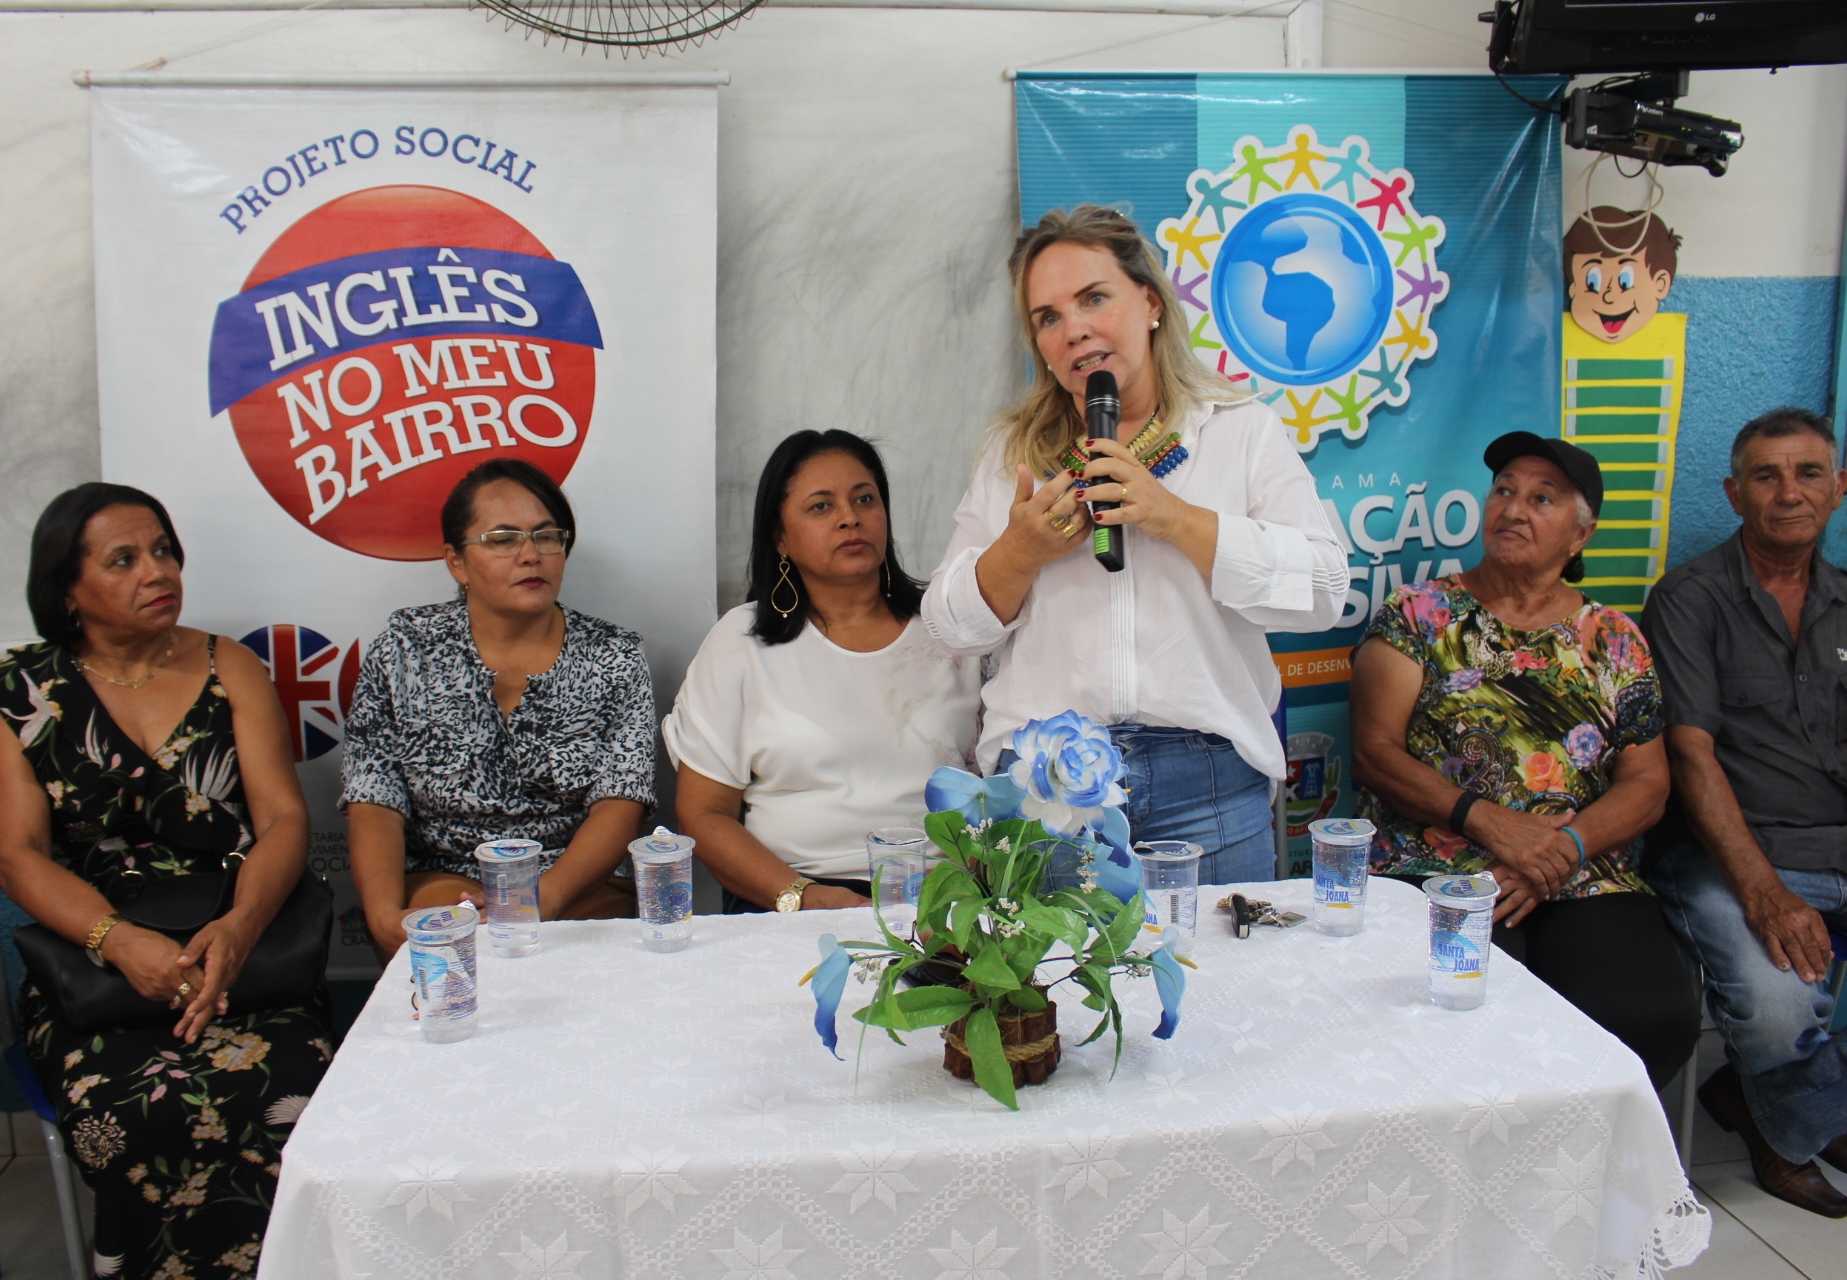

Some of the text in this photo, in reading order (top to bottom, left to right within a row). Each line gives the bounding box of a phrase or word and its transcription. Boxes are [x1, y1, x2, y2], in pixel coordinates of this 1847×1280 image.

[1705, 13, 1716, 21] LG
[219, 125, 538, 234] PROJETO SOCIAL
[254, 247, 540, 371] INGLÊS
[277, 338, 556, 449] NO MEU
[294, 395, 579, 525] BAIRRO
[1287, 663, 1303, 676] DE
[309, 845, 349, 855] VIMEN
[310, 857, 351, 872] OCI
[1289, 860, 1312, 876] AF
[1325, 891, 1349, 902] JOANA
[1438, 943, 1465, 959] SANTA
[1453, 958, 1480, 972] JOANA
